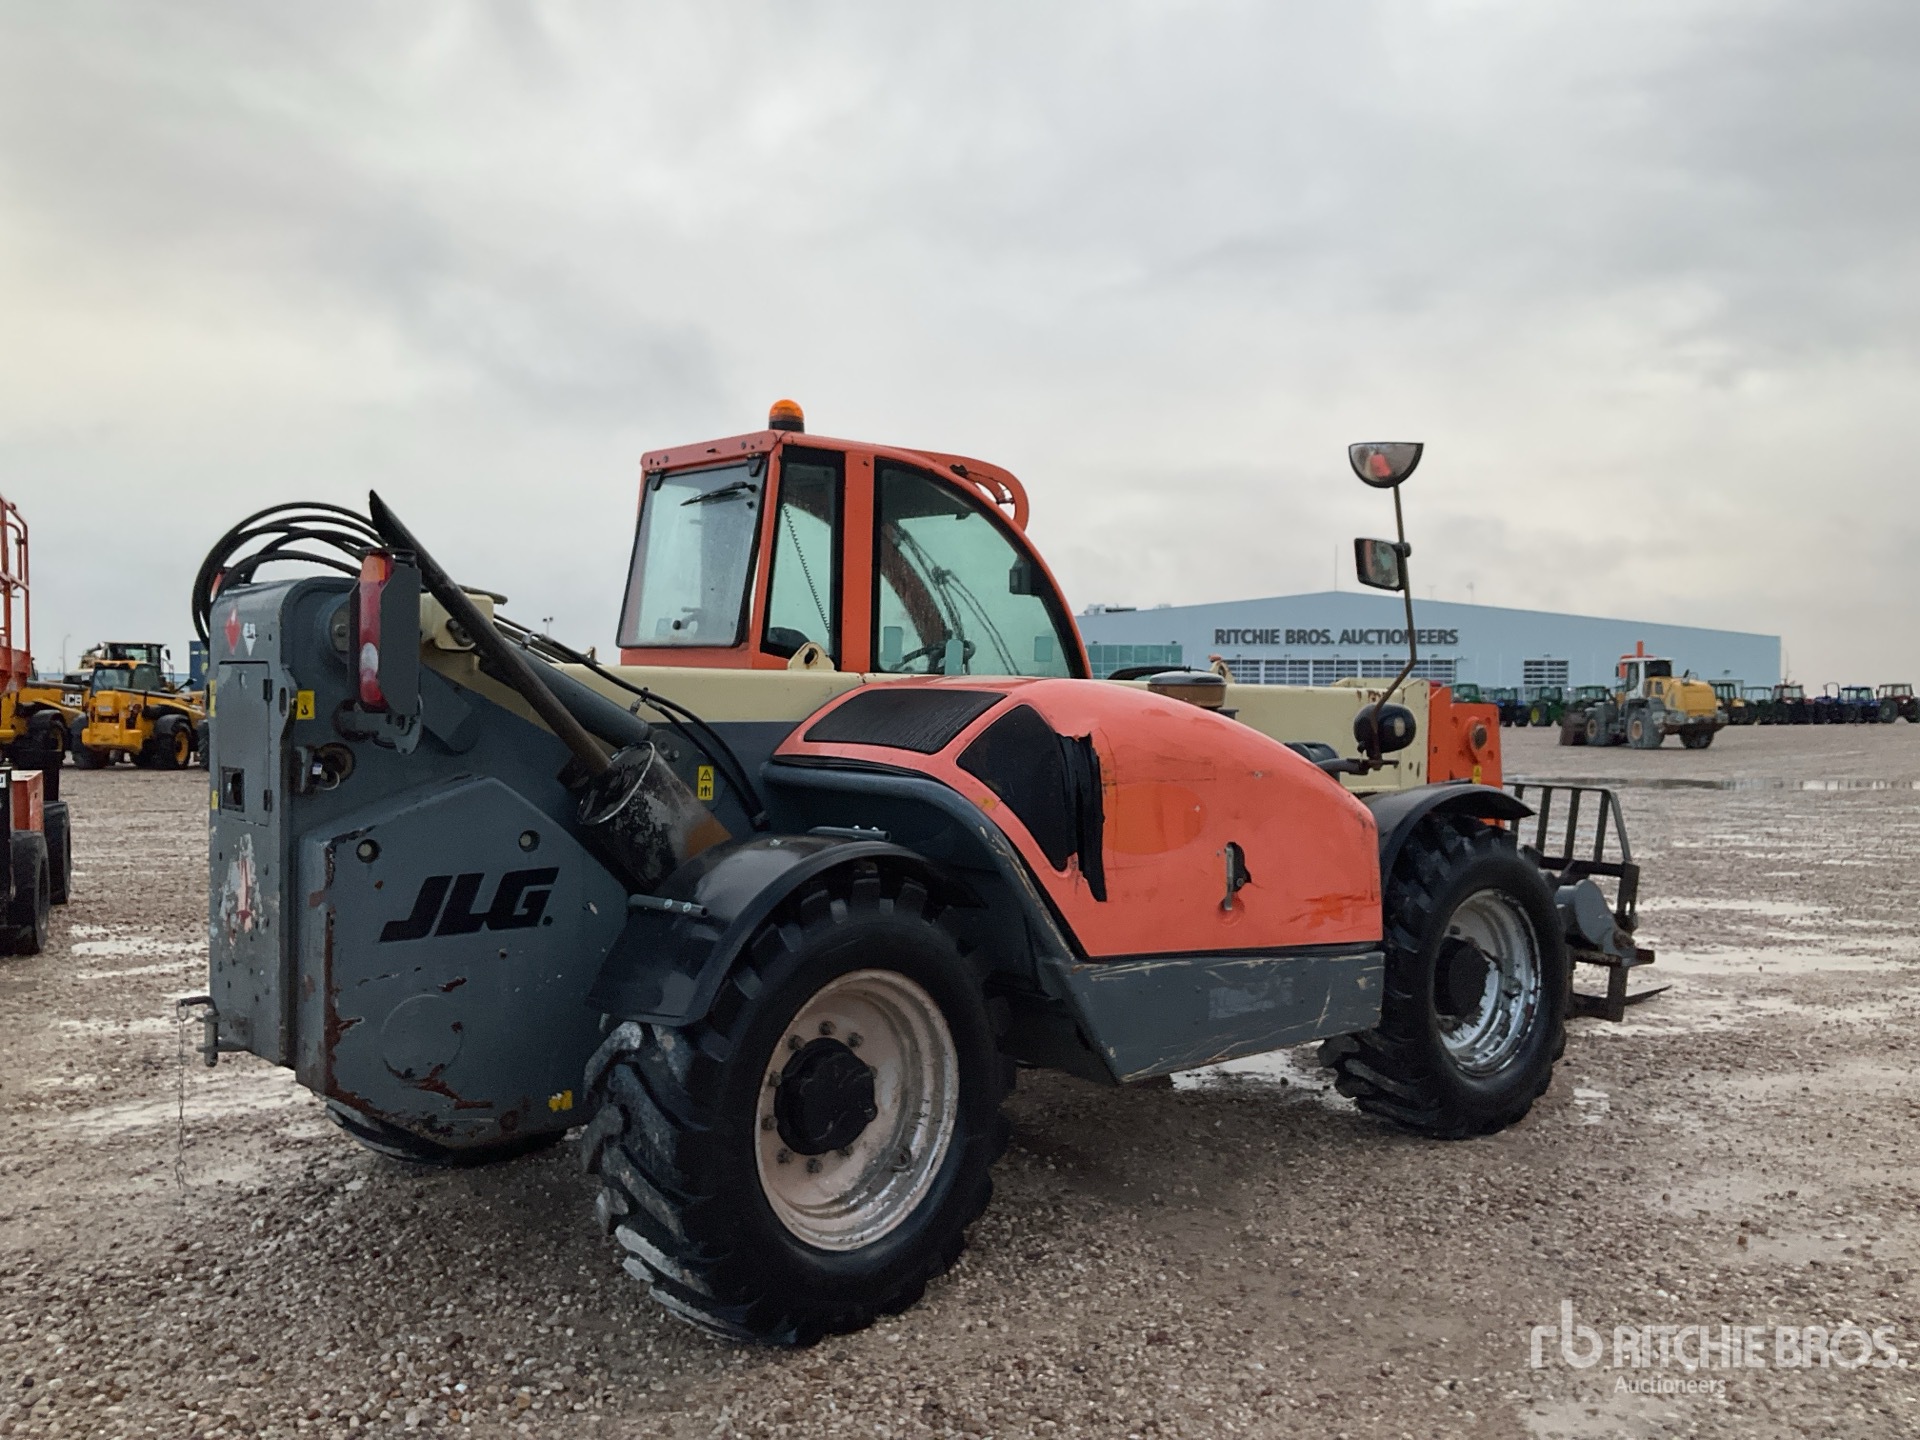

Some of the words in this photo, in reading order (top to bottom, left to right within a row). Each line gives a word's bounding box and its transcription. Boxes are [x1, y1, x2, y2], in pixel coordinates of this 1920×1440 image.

[1214, 628, 1280, 645] RITCHIE
[1285, 628, 1335, 645] BROS.
[61, 693, 82, 706] JCB
